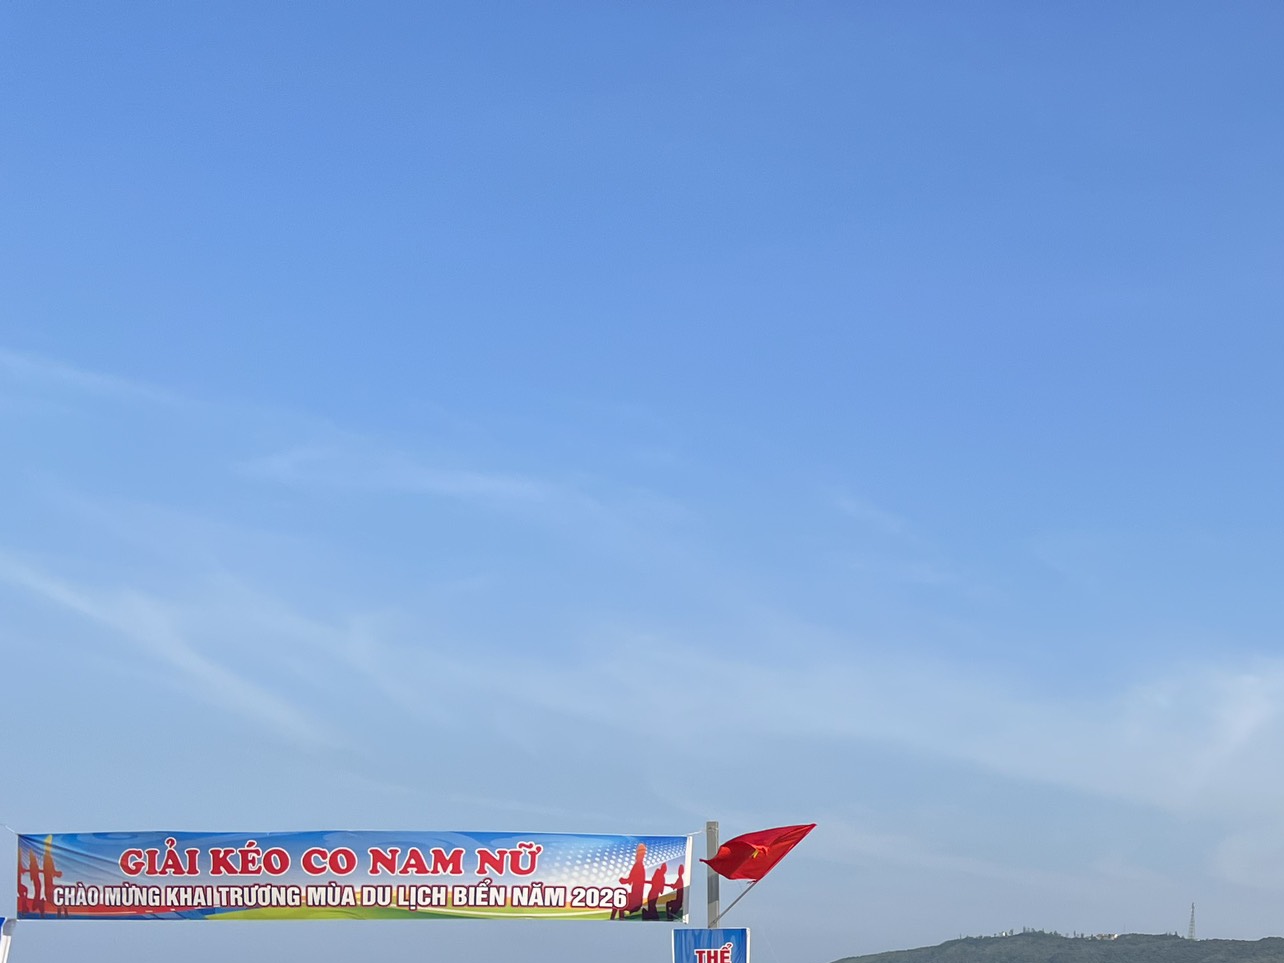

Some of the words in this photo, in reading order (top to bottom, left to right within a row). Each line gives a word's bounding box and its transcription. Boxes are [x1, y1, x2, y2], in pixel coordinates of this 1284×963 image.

[120, 837, 200, 876] GIẢI
[210, 840, 290, 876] KÉO
[302, 847, 357, 876] CO
[369, 847, 465, 876] NAM
[476, 841, 542, 876] NỮ
[53, 883, 104, 907] CHÀO
[105, 883, 161, 907] MỪNG
[166, 886, 212, 907] KHAI
[219, 885, 300, 907] TRƯƠNG
[306, 882, 355, 907] MÙA
[362, 886, 391, 907] DU
[398, 886, 443, 910] LỊCH
[453, 878, 506, 907] BIỂN
[512, 882, 563, 907] NĂM
[571, 888, 628, 908] 2026
